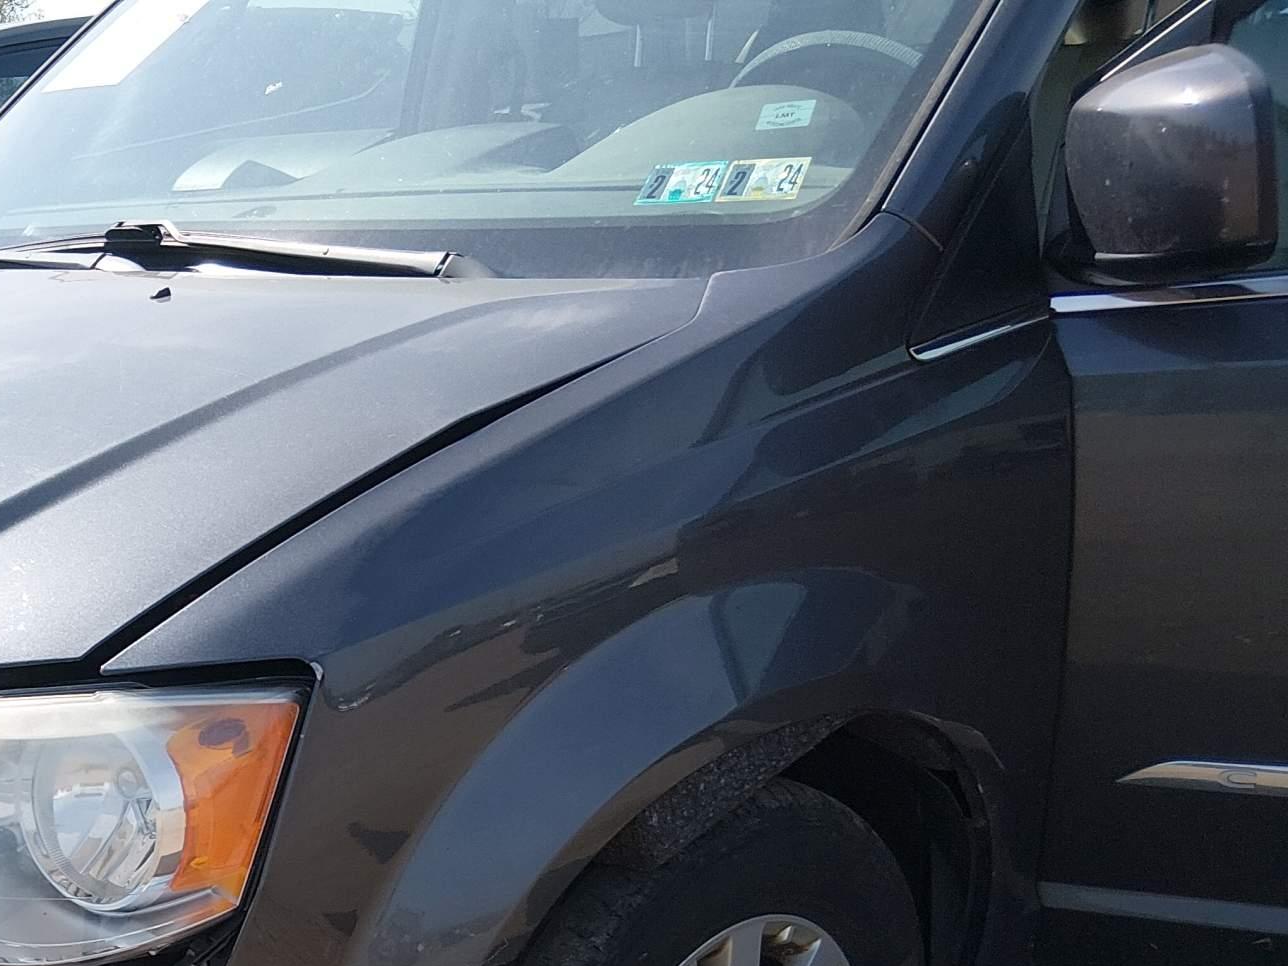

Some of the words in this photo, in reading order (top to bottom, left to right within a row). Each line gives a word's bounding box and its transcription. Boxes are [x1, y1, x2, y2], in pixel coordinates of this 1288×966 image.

[646, 174, 667, 199] 2
[693, 167, 721, 195] 24
[727, 171, 748, 196] 2
[775, 163, 804, 192] 24
